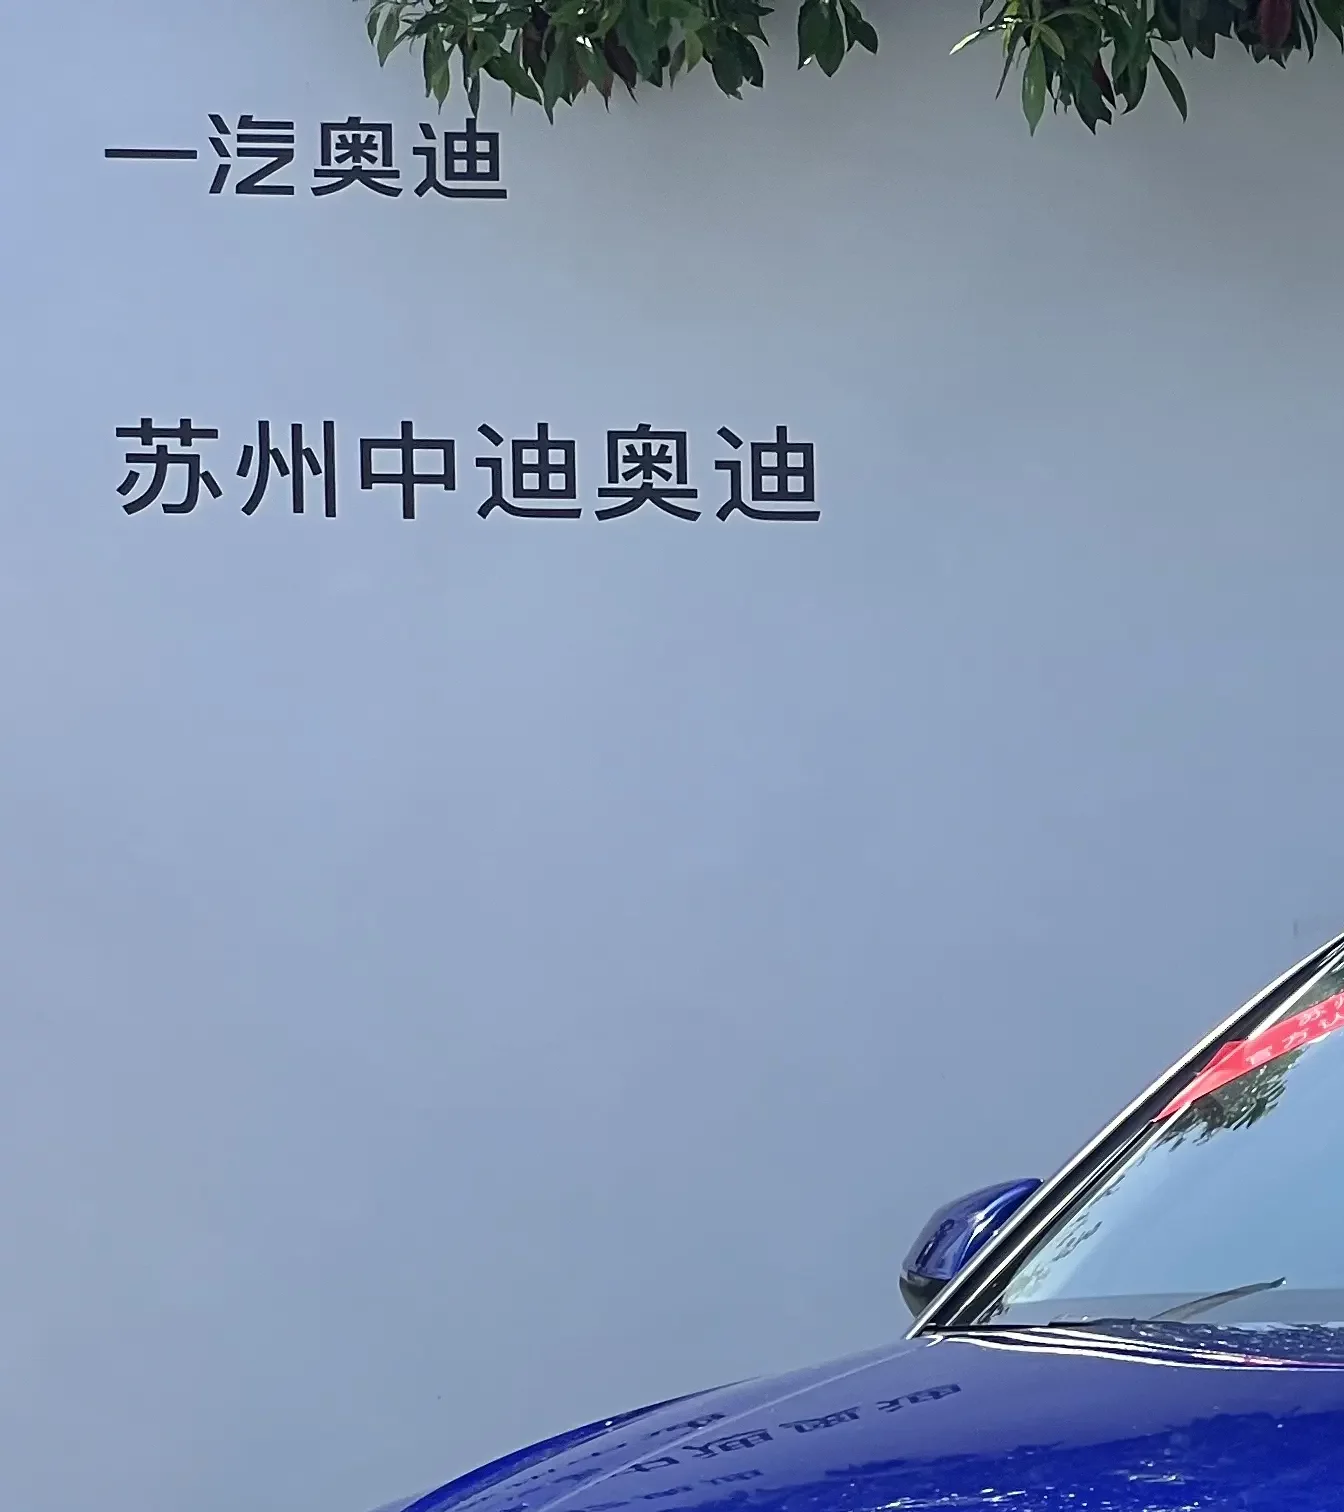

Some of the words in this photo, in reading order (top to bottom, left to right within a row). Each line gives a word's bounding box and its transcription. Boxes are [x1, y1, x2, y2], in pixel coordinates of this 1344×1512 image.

[103, 113, 509, 200] 一汽奥迪
[114, 416, 823, 523] 苏州中迪奥迪
